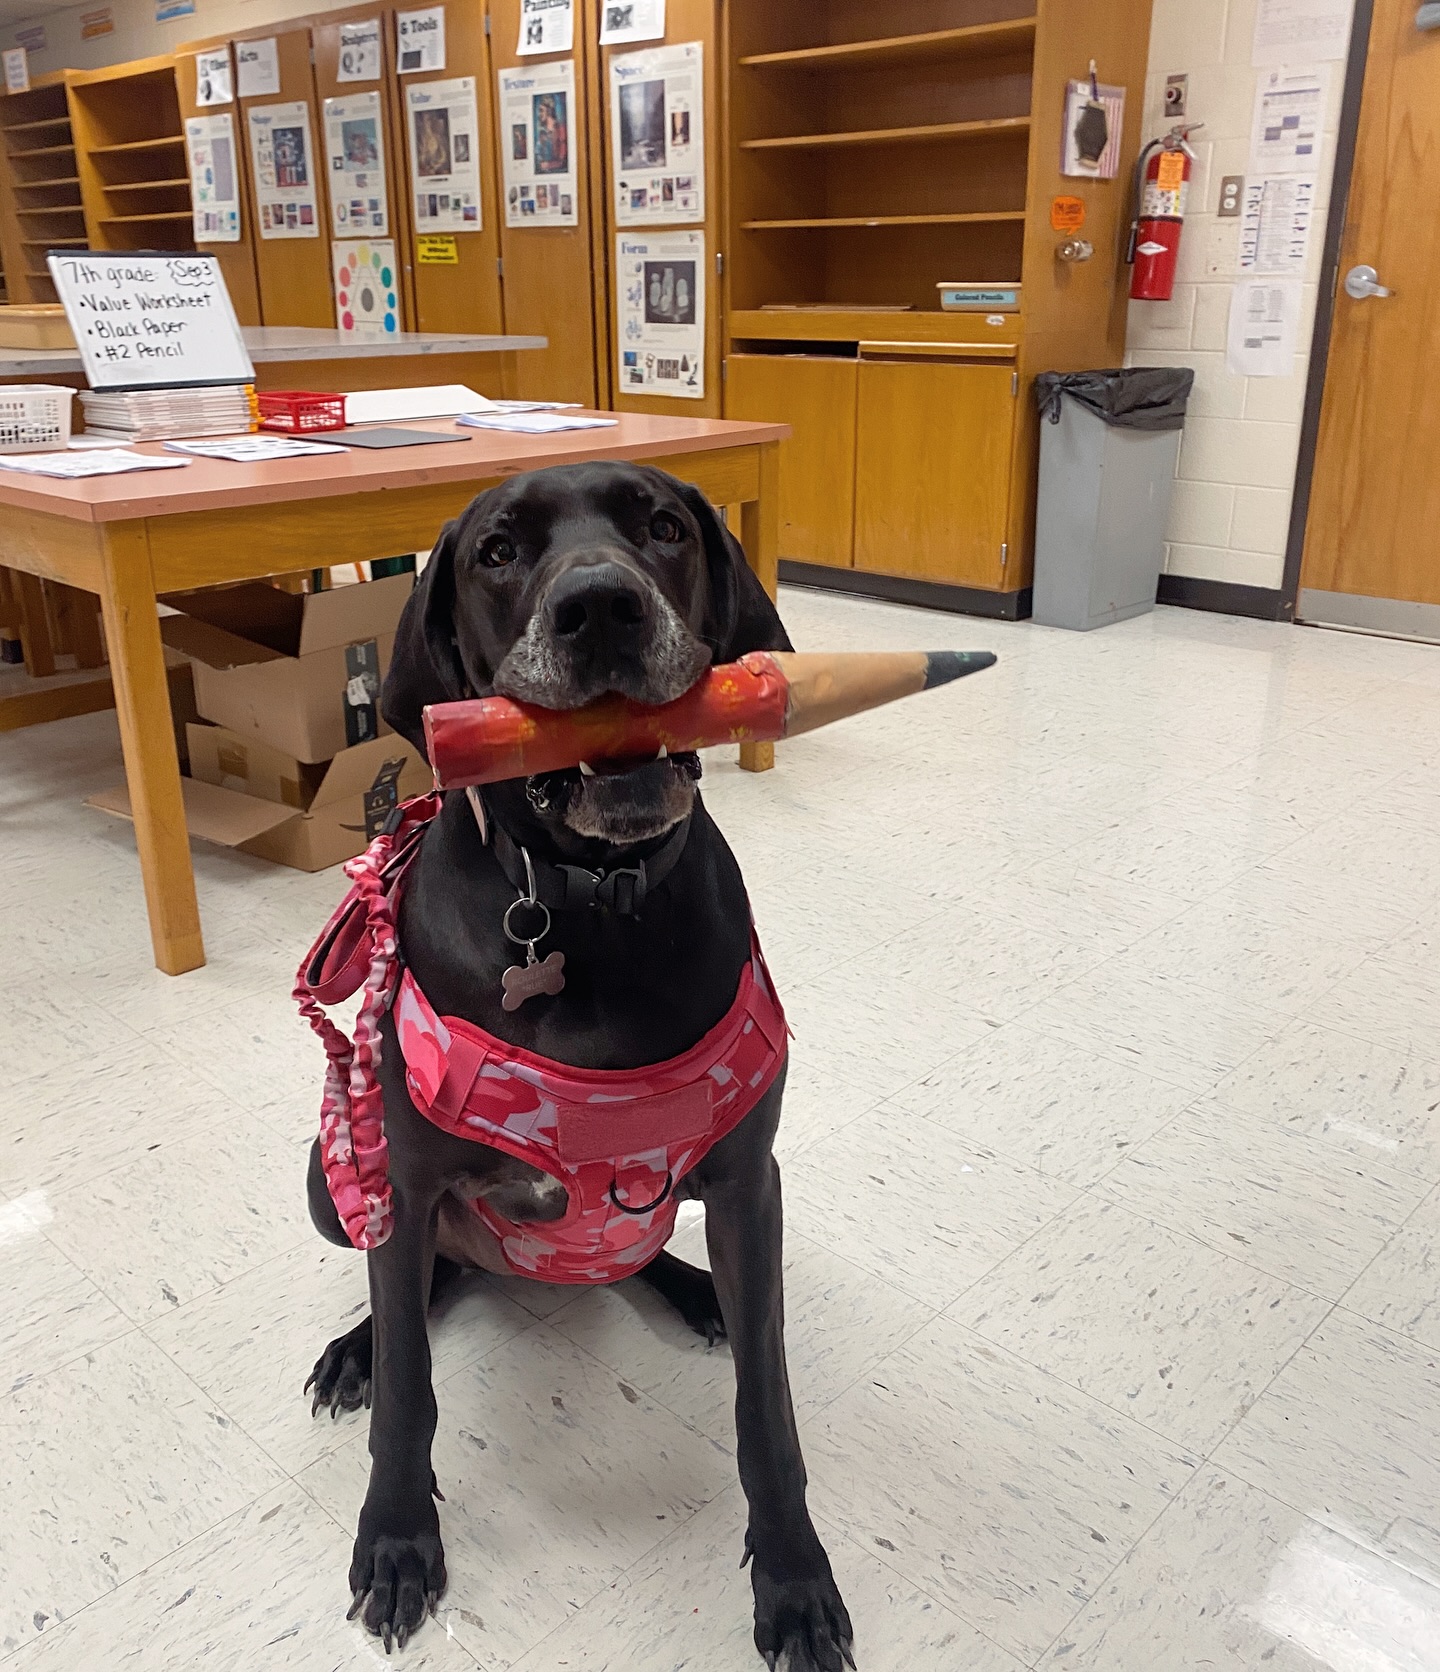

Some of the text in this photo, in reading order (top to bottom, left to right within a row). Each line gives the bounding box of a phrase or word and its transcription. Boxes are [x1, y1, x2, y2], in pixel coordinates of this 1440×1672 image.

[524, 0, 570, 13] Painting
[401, 17, 438, 34] & Tools
[622, 242, 647, 254] Form
[62, 261, 102, 283] 7th
[82, 294, 211, 312] Value Worksheet
[955, 293, 979, 301] Colored
[95, 318, 188, 338] Black Paper
[104, 341, 184, 361] #2 Pencil
